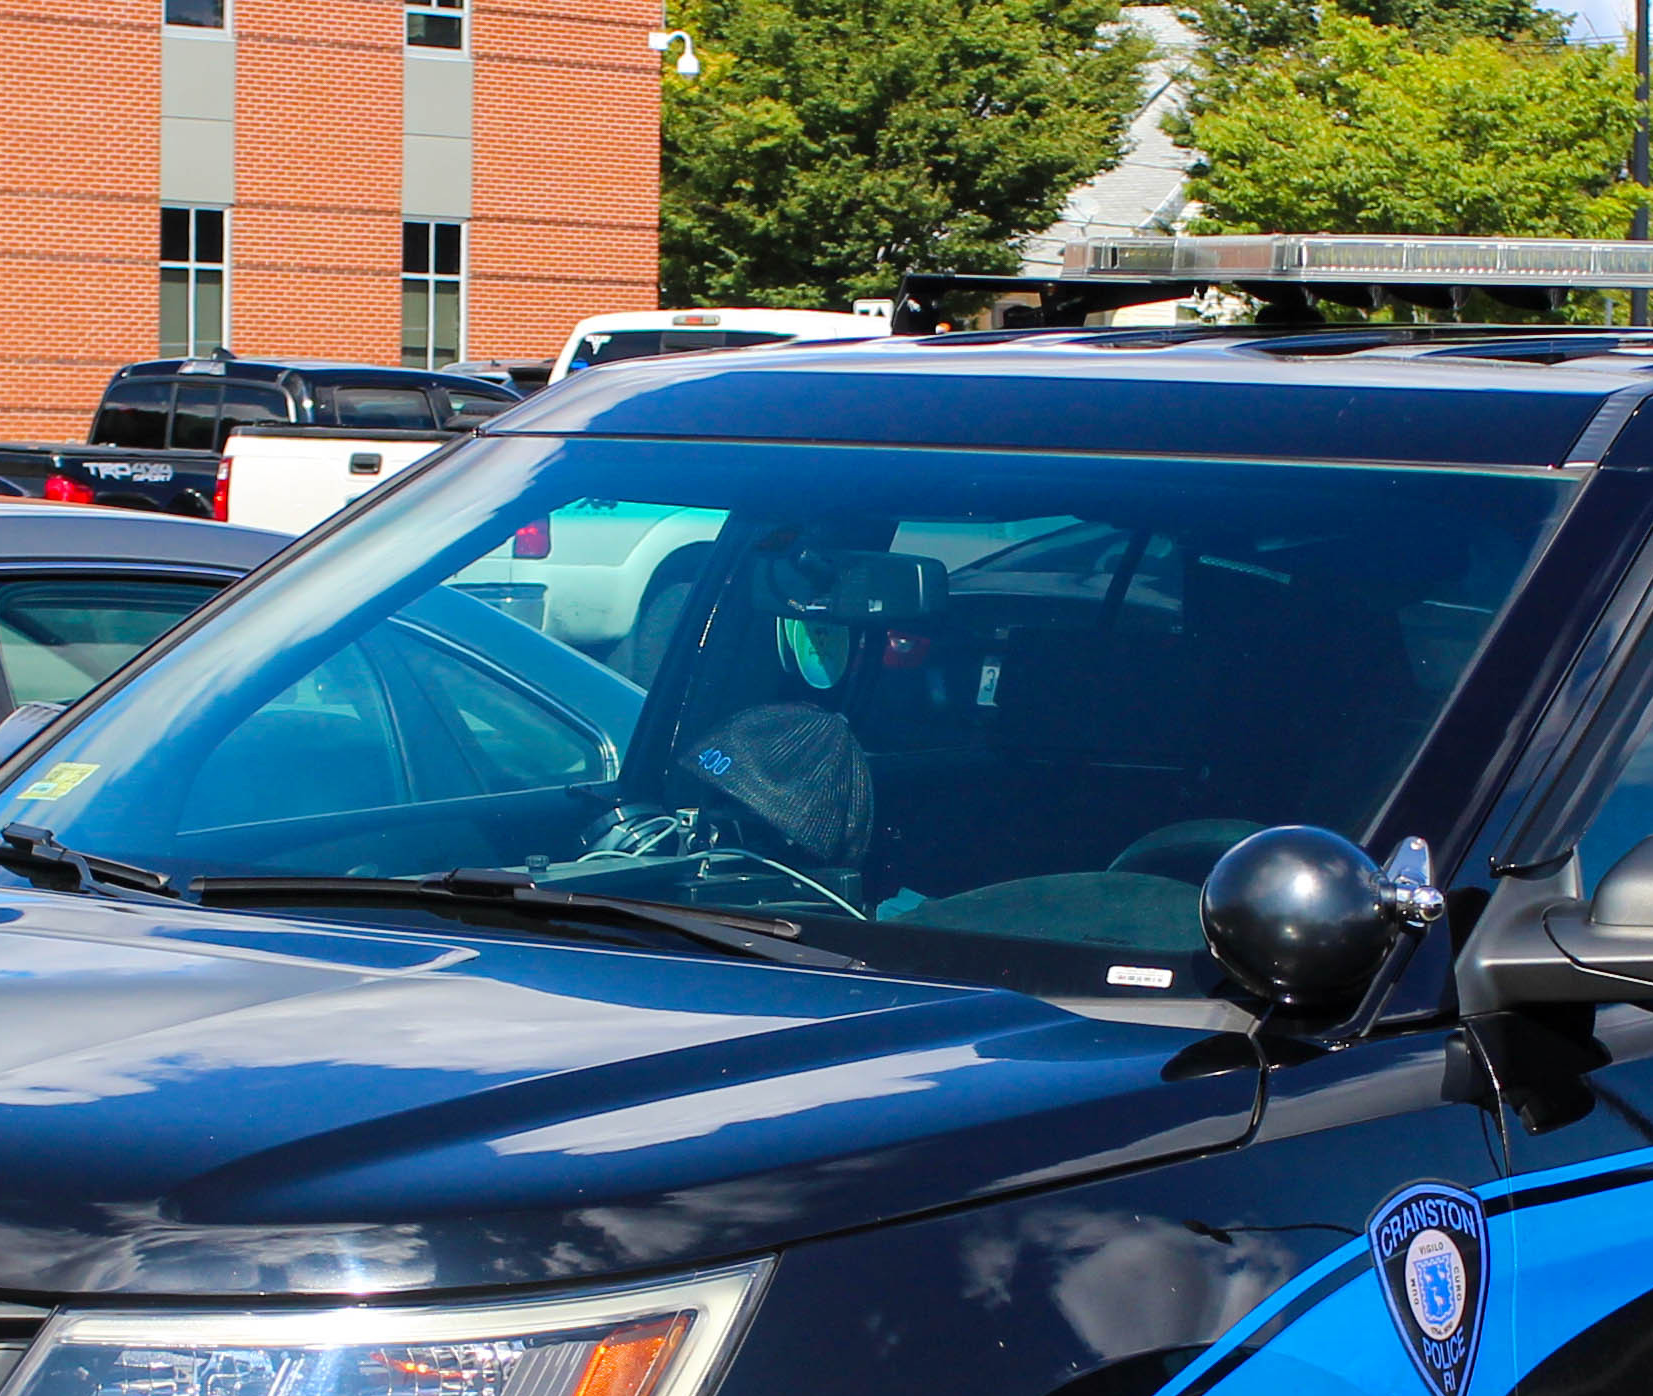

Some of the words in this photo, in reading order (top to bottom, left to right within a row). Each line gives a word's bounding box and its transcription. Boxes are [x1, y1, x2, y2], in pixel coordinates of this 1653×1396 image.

[1380, 1198, 1477, 1258] CRANSTON
[1422, 1325, 1466, 1371] POLICE
[1443, 1371, 1456, 1393] RI
